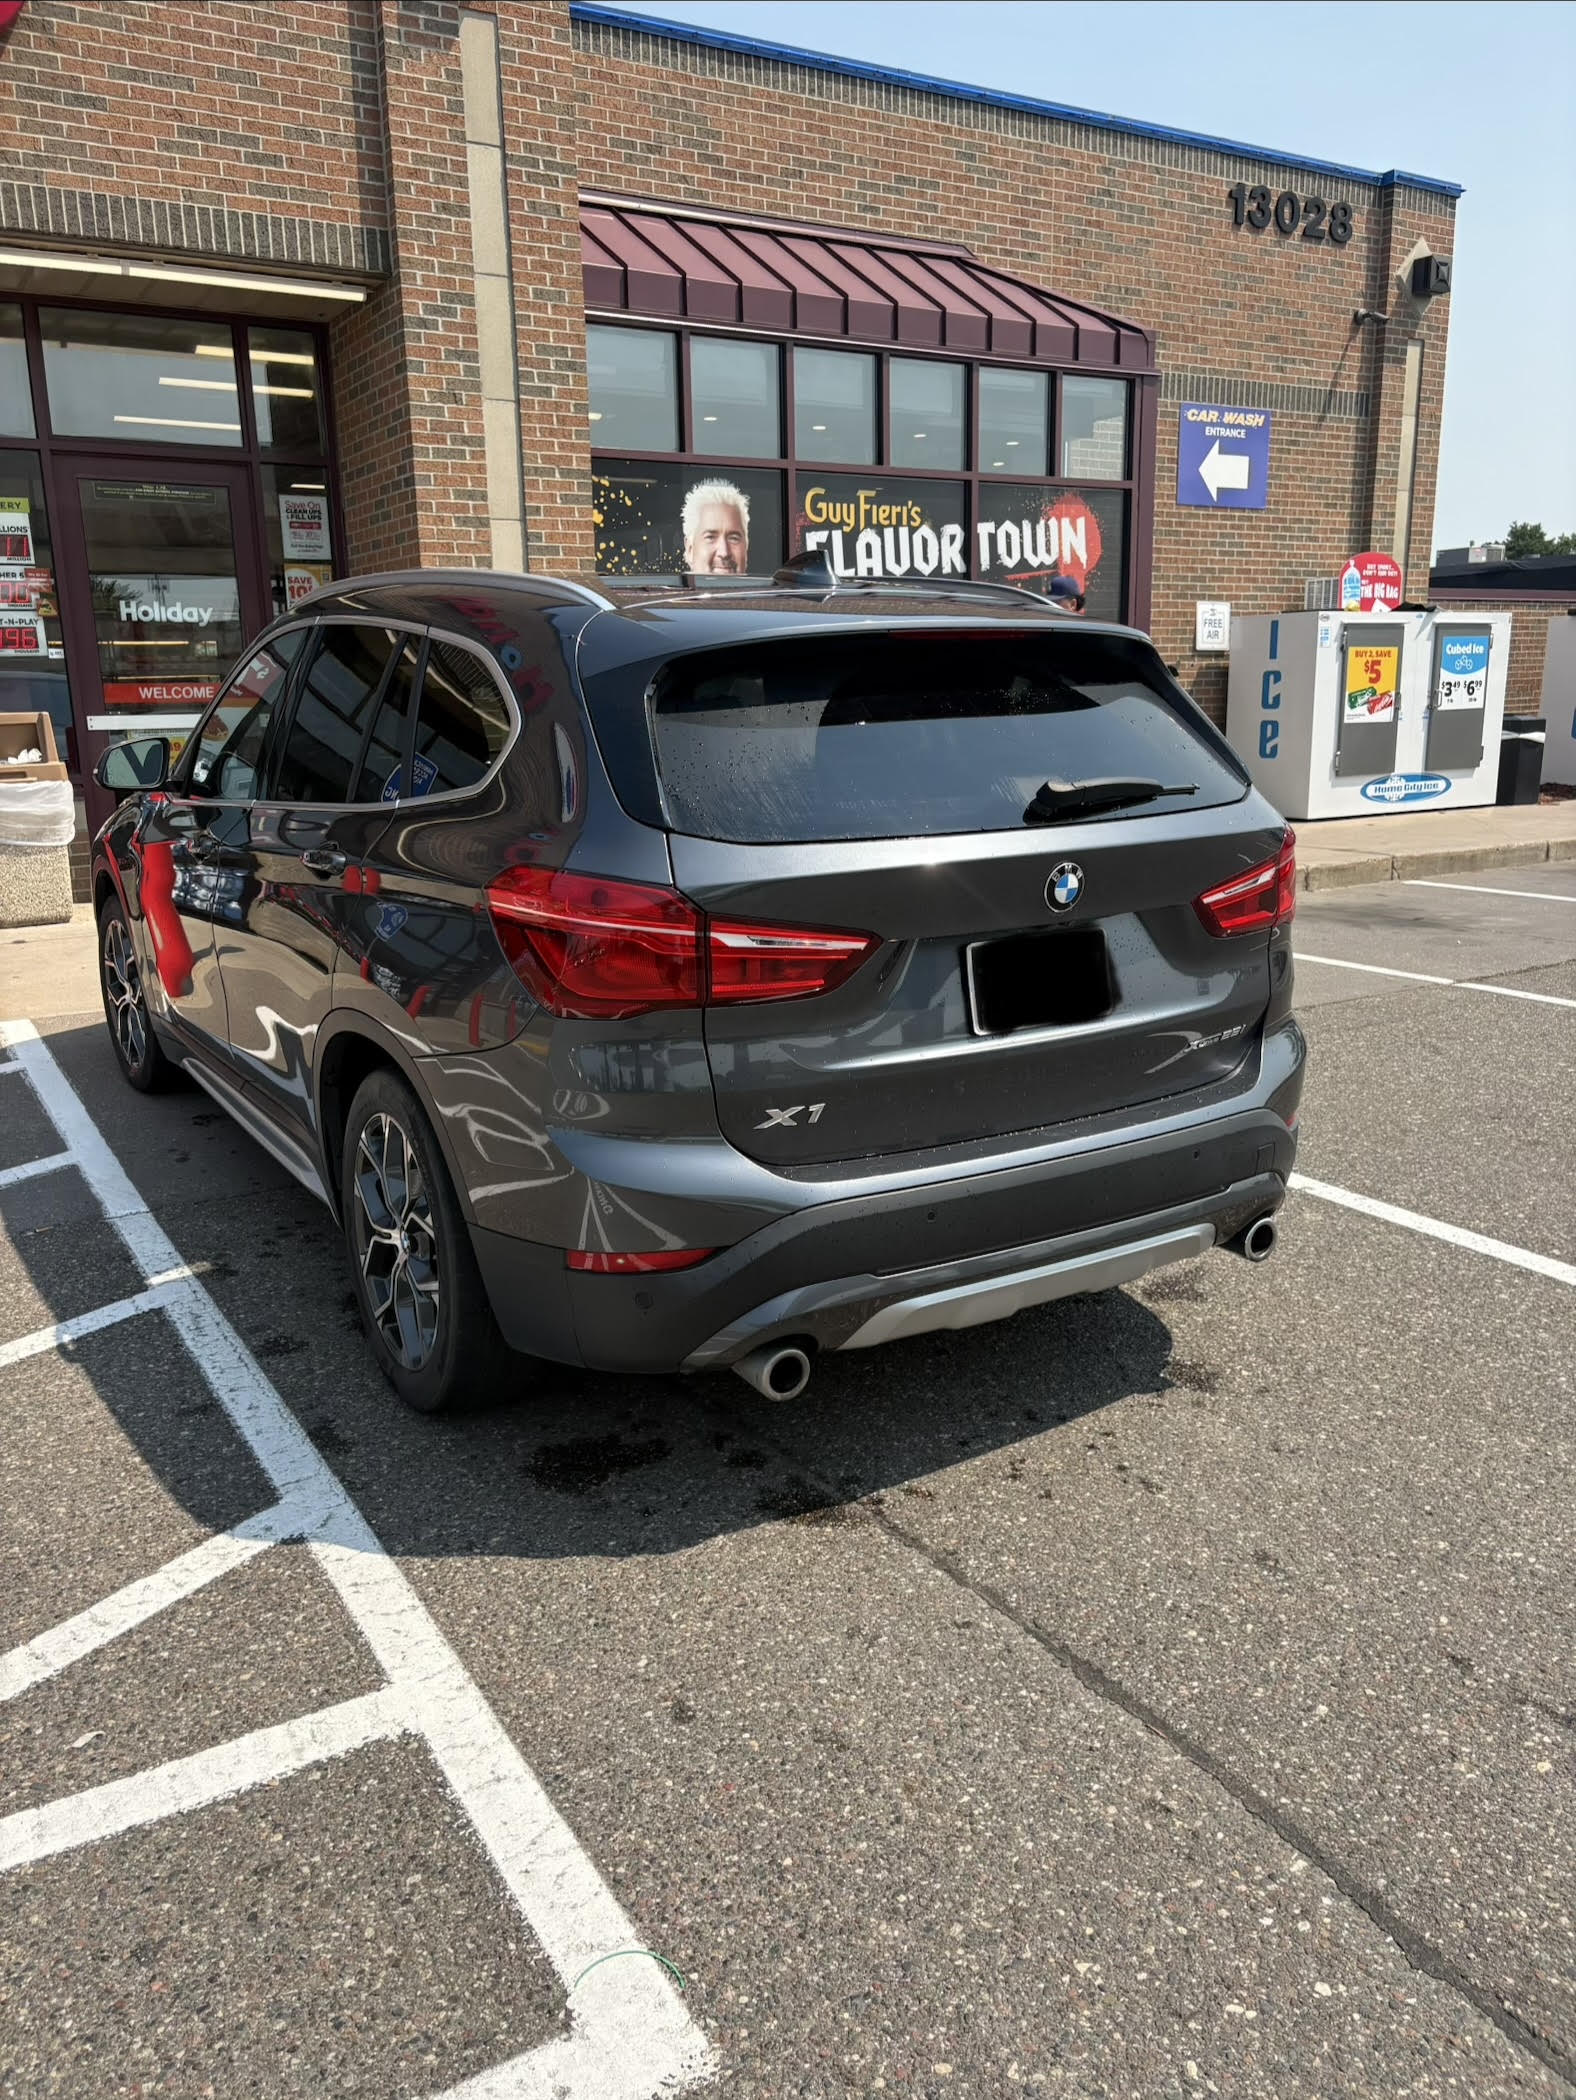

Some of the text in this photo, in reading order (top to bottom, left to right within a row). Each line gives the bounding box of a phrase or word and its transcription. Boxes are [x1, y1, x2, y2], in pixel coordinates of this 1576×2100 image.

[1228, 183, 1353, 243] 13028
[1186, 408, 1265, 428] CAR WASH
[1205, 426, 1246, 439] ENTRANCE
[0, 501, 21, 510] ERY
[286, 501, 321, 509] Save On
[805, 487, 921, 533] Guy Fieri's
[805, 516, 1087, 577] FLAVOR TOWN
[0, 571, 17, 579] HER
[288, 576, 313, 585] SAVE
[1360, 584, 1373, 599] THE
[1374, 582, 1385, 599] BIG
[1386, 584, 1398, 599] BAG
[120, 600, 213, 627] Holiday
[0, 618, 38, 626] T-N-PLAY
[1204, 618, 1223, 629] FREE
[1207, 630, 1220, 640] AIR
[1355, 650, 1368, 658] BUY
[1376, 650, 1392, 658] SAVE
[1446, 643, 1485, 655] Cubed Ice
[1364, 660, 1382, 684] $5
[138, 686, 215, 699] WELCOME
[752, 1103, 826, 1130] X1
